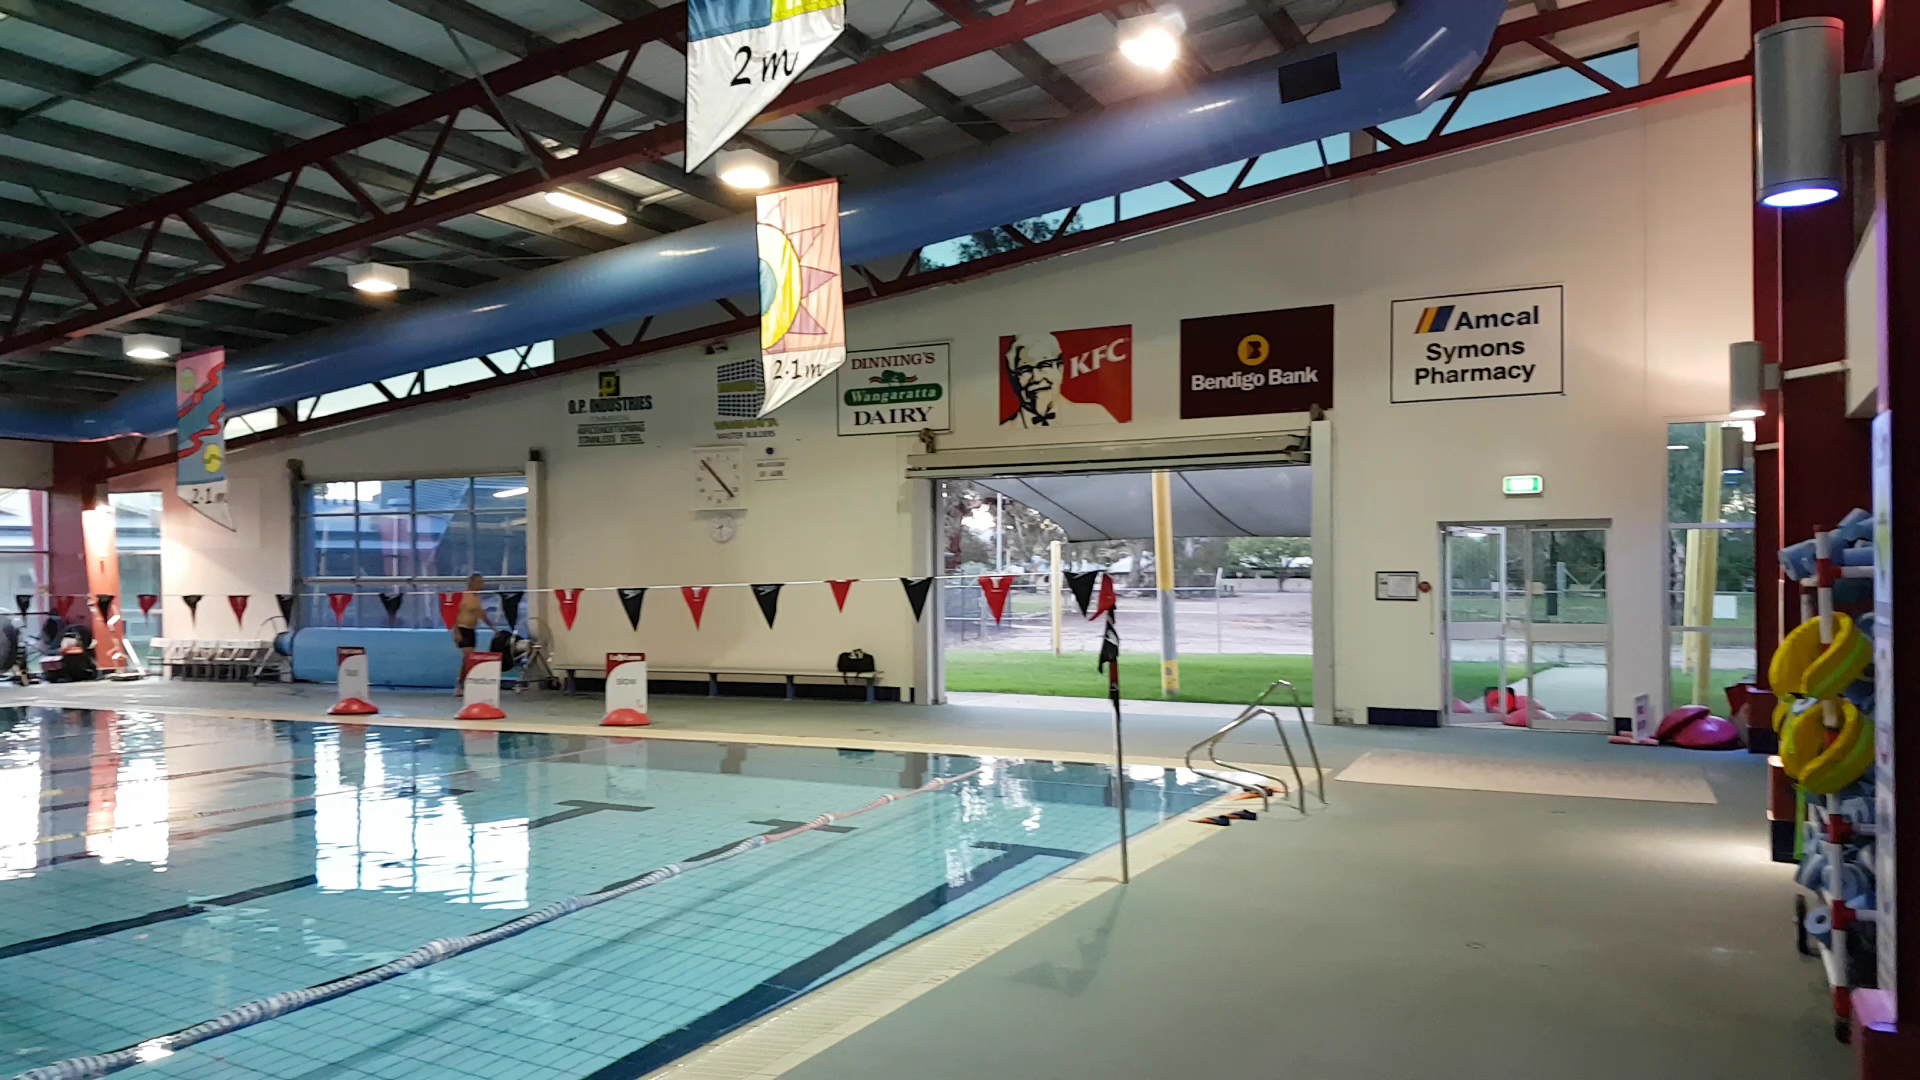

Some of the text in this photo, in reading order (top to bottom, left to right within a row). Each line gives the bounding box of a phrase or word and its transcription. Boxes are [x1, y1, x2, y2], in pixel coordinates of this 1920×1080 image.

[1454, 305, 1540, 331] Amcal
[851, 351, 936, 370] DINNING'S
[1069, 338, 1127, 379] KFC
[1426, 339, 1525, 365] Symons
[1191, 365, 1319, 392] Bendigo Bank
[1414, 363, 1537, 386] Pharmacy
[850, 386, 937, 405] Wangaratta
[853, 406, 934, 427] DAIRY
